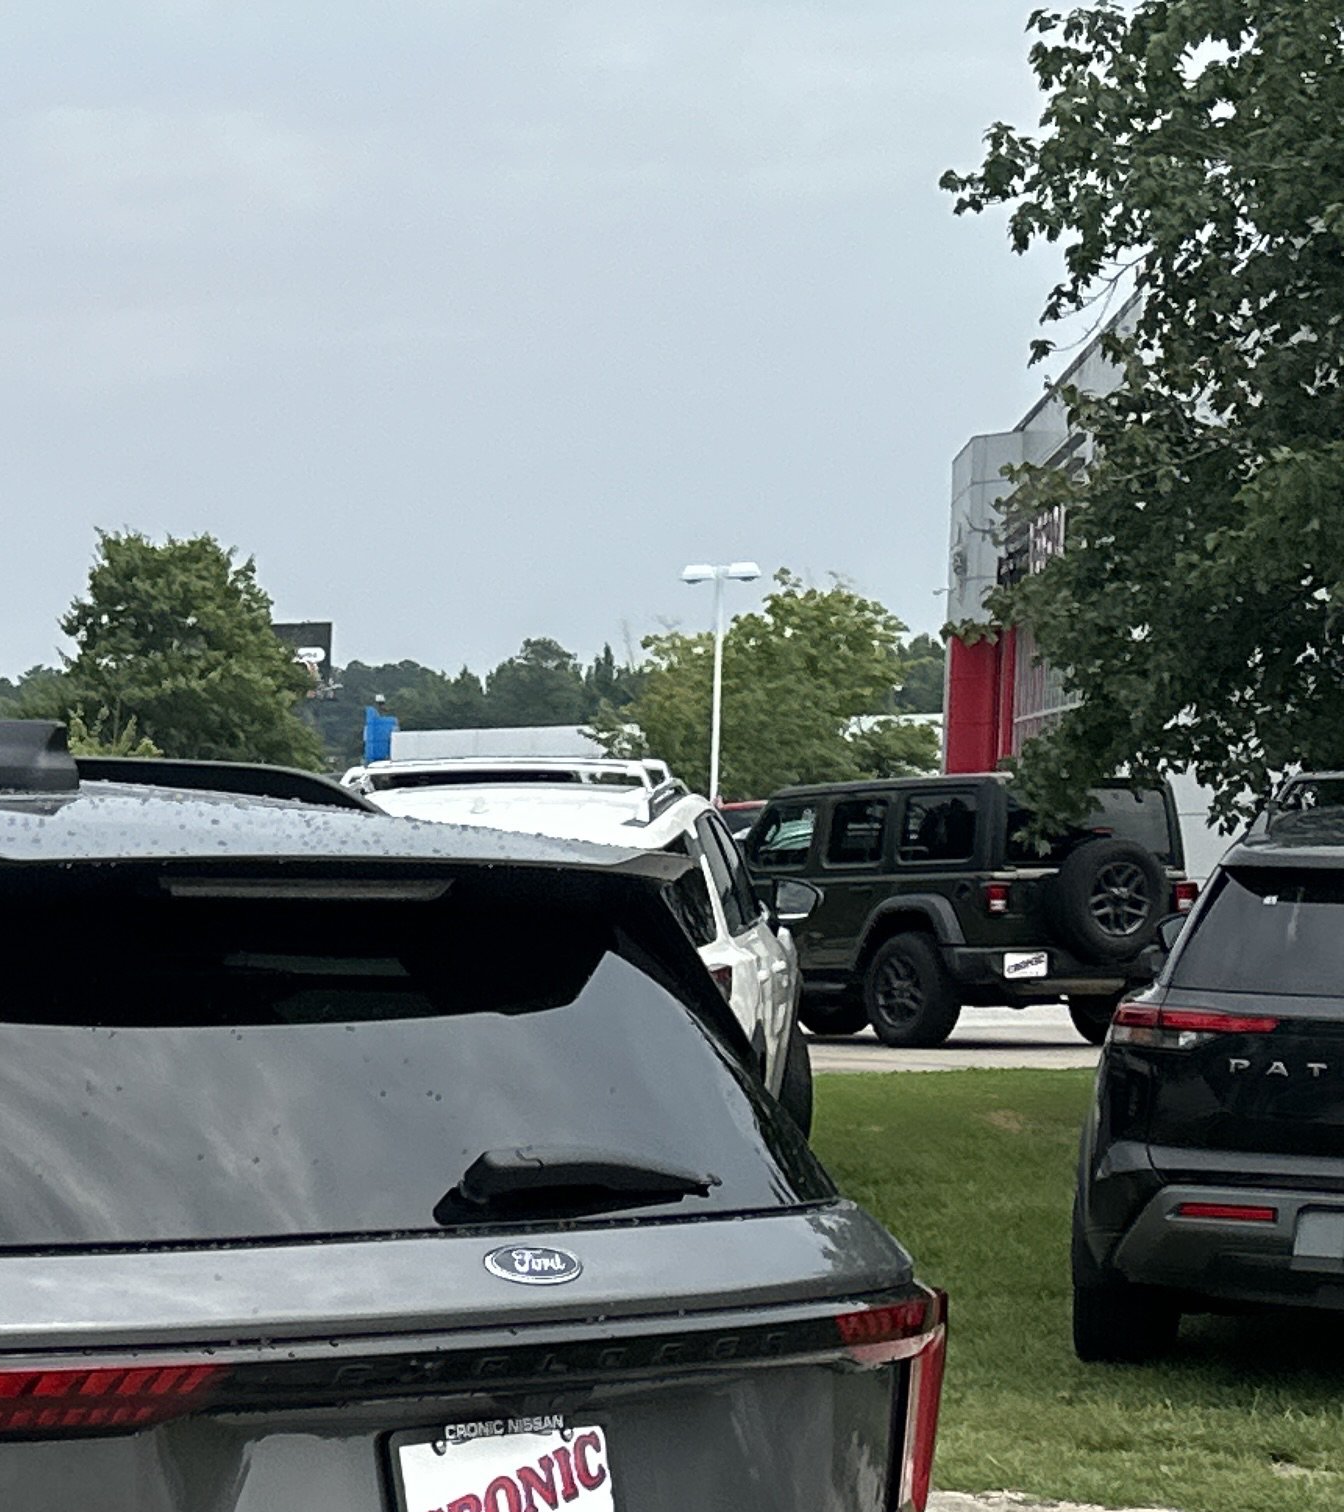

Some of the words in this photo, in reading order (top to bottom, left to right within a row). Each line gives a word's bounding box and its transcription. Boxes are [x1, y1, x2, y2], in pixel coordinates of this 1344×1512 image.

[1228, 1058, 1328, 1077] PAT
[511, 1248, 566, 1274] Ford
[444, 1419, 505, 1440] CRONIC
[507, 1414, 564, 1435] NISSAN
